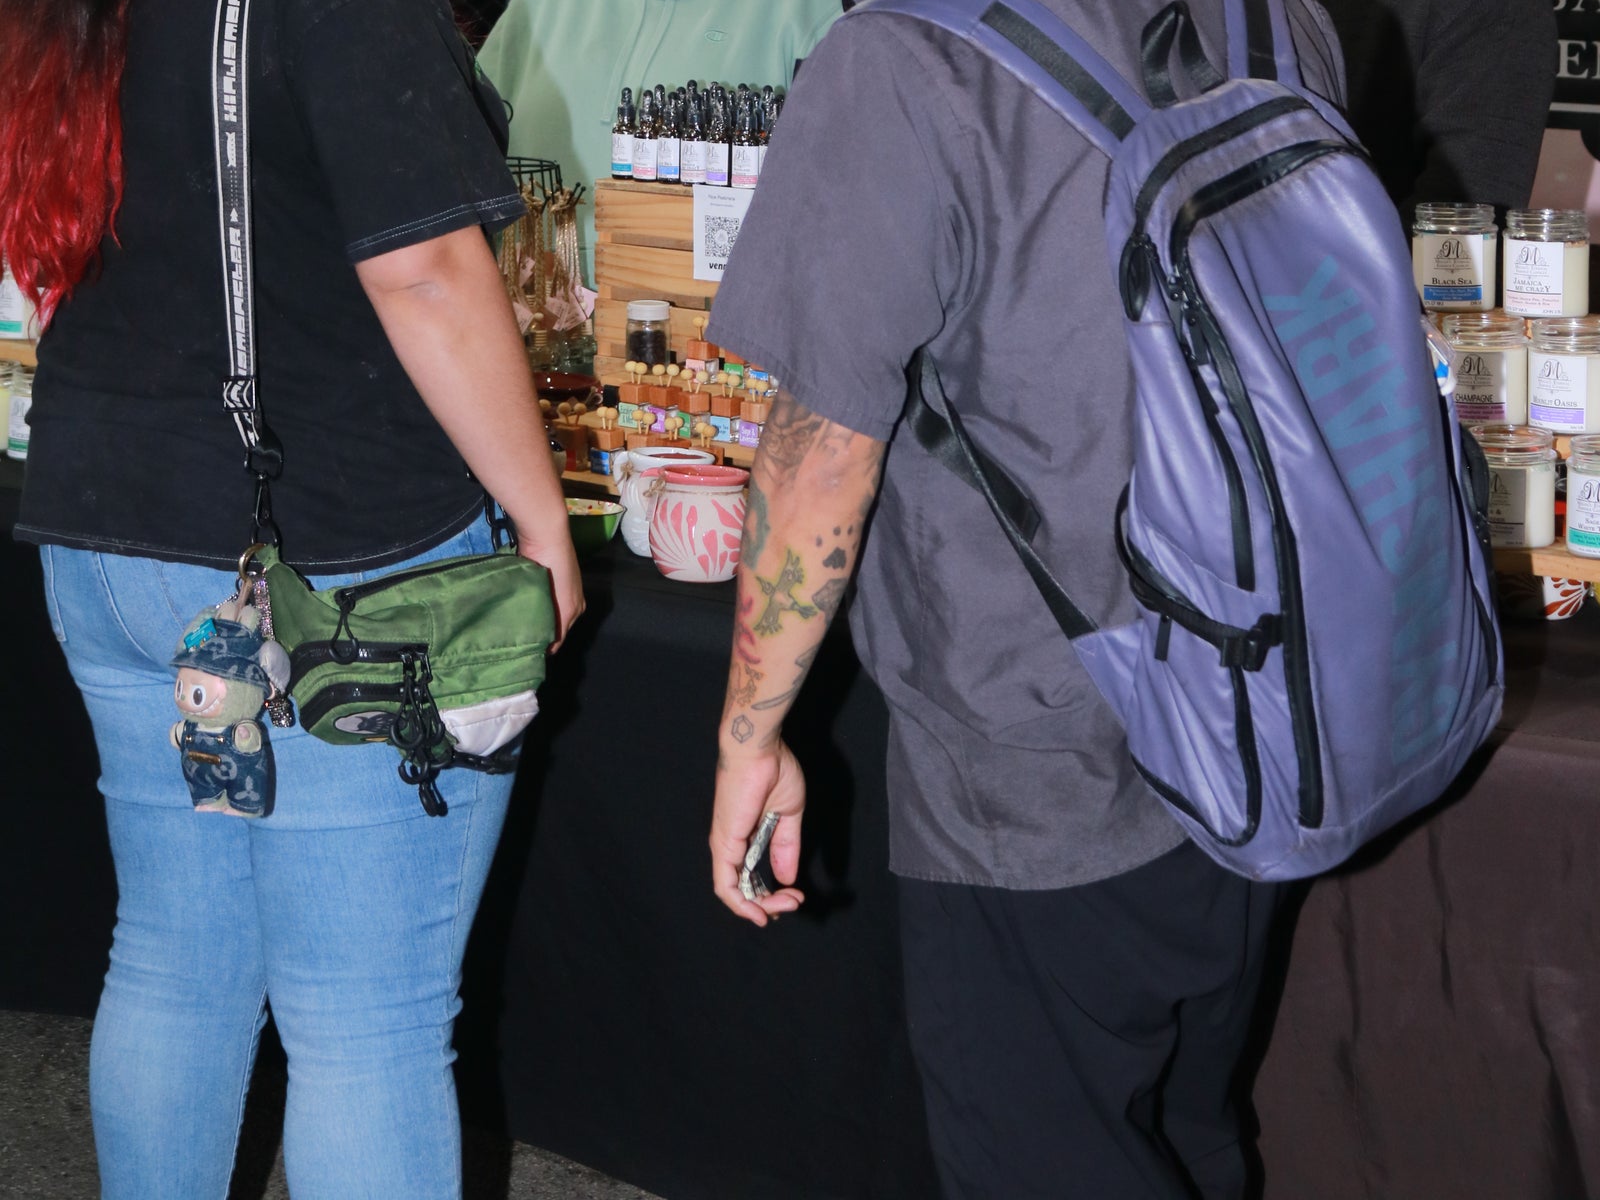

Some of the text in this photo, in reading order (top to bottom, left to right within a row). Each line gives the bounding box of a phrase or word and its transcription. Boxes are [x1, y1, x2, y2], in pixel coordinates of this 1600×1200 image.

[1458, 277, 1473, 285] SEA
[1513, 277, 1543, 287] JAMAICA
[1526, 285, 1550, 293] CRAZY
[1455, 393, 1494, 403] CHAMPAGNE
[1554, 398, 1578, 407] OASIS
[1263, 255, 1459, 766] GYMSHARK
